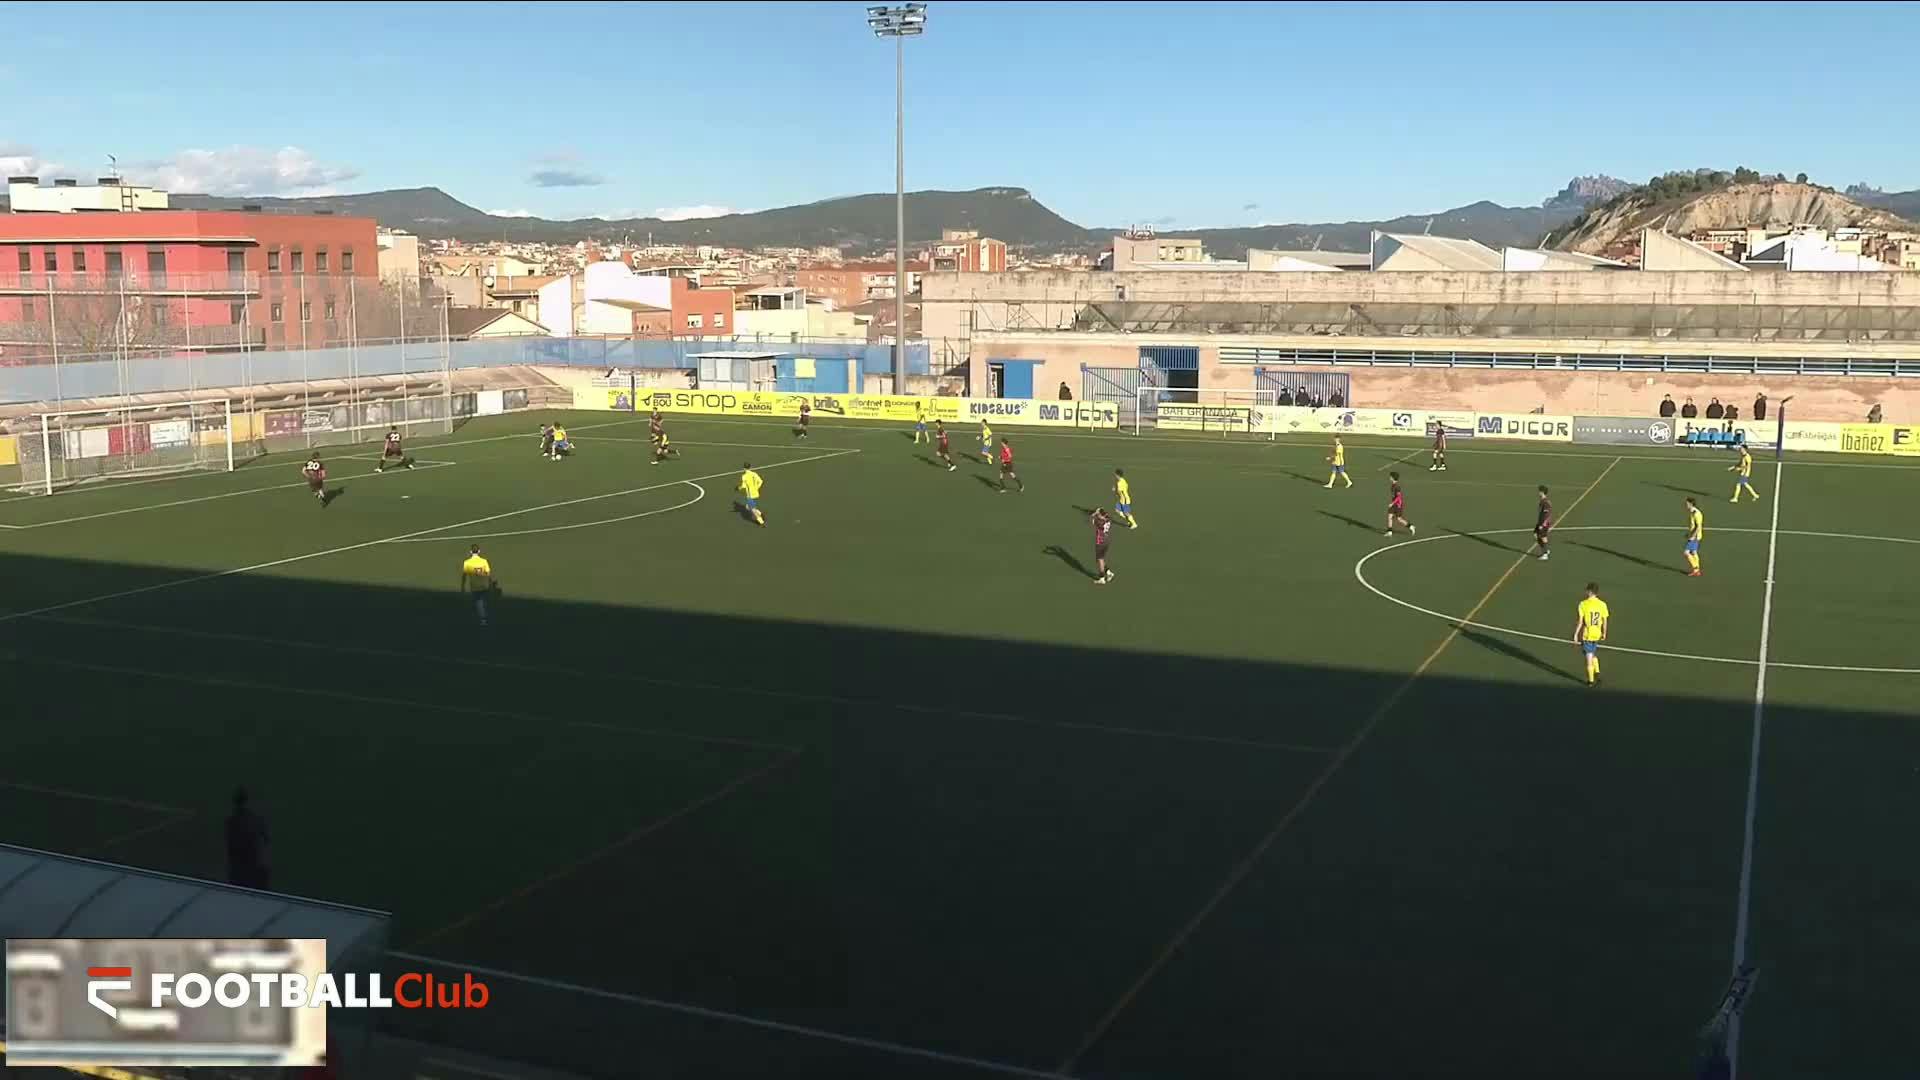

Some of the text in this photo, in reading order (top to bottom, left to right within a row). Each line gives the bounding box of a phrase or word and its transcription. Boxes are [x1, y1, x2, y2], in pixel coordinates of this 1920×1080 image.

[676, 393, 736, 412] snop
[970, 402, 1020, 415] KIDS&US
[1507, 420, 1569, 436] DICOR
[390, 433, 401, 442] 22
[307, 461, 320, 471] 20
[1590, 611, 1600, 626] 12
